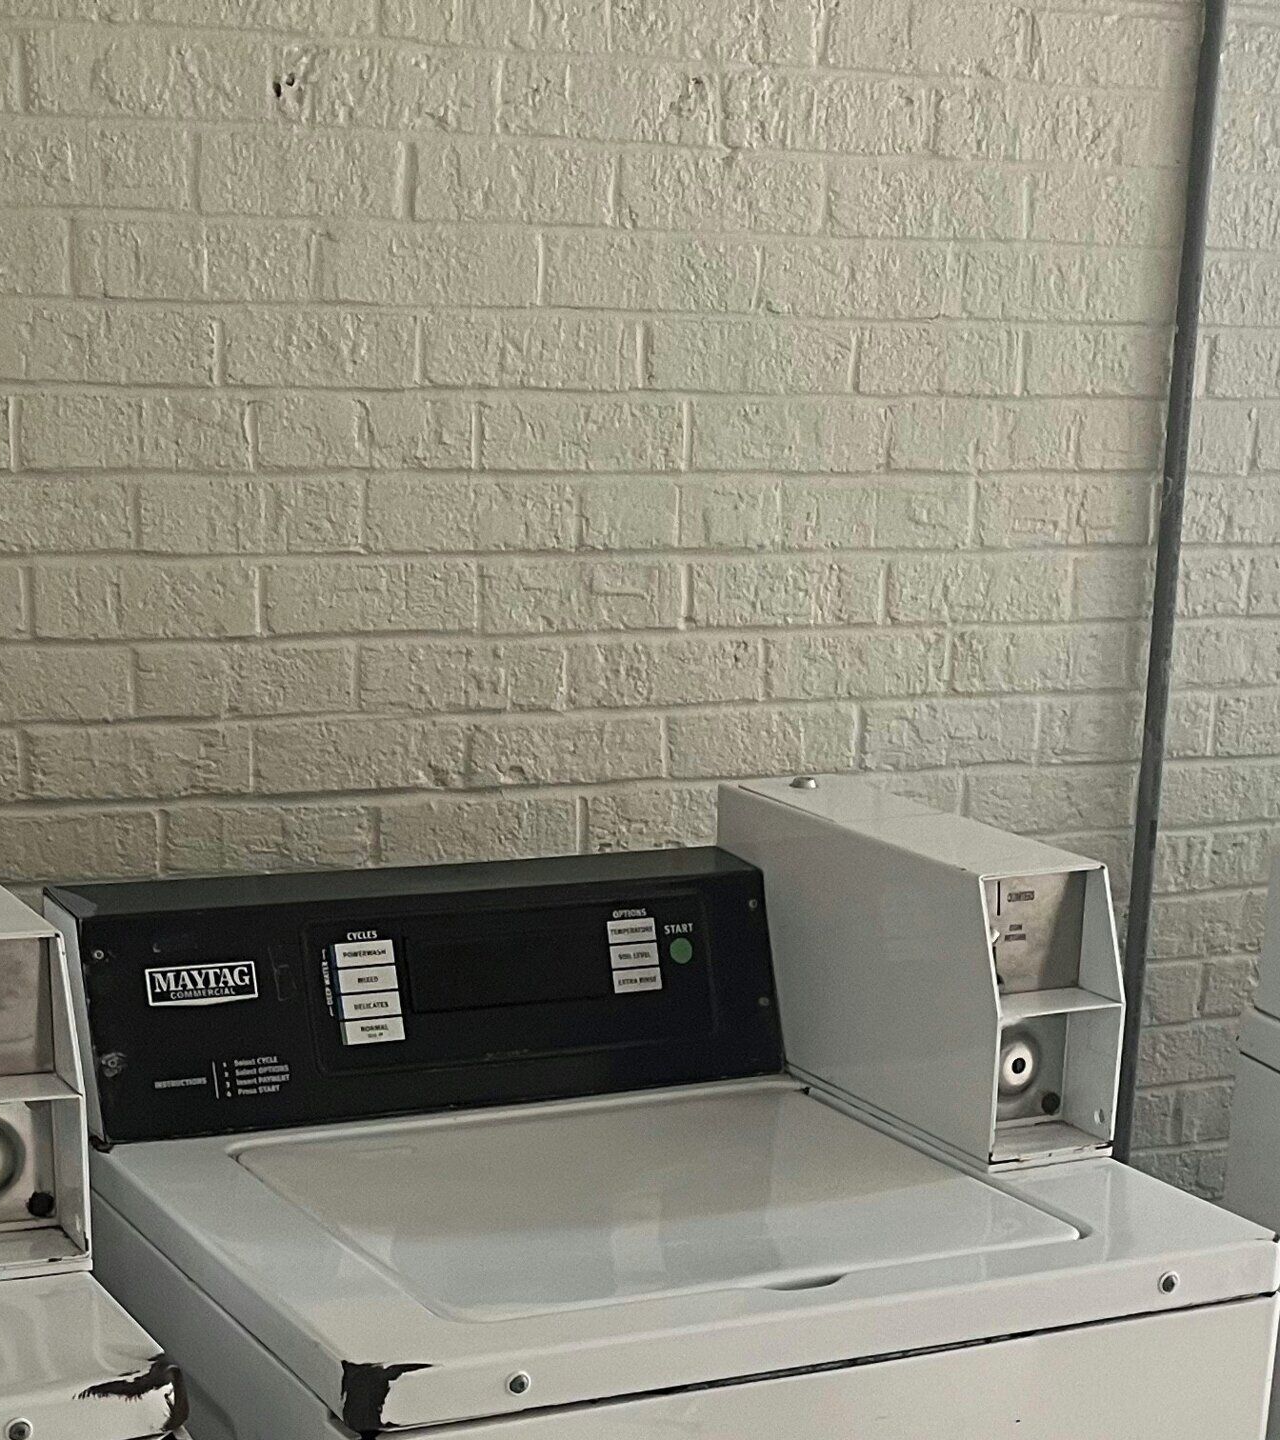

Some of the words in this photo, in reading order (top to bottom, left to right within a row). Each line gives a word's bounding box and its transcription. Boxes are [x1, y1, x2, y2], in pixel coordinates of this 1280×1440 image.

[612, 908, 647, 918] OPTIONS
[347, 930, 378, 940] CYCLES
[664, 923, 694, 935] START
[152, 966, 250, 993] MAYTAG
[170, 987, 236, 1000] COMMERCIAL
